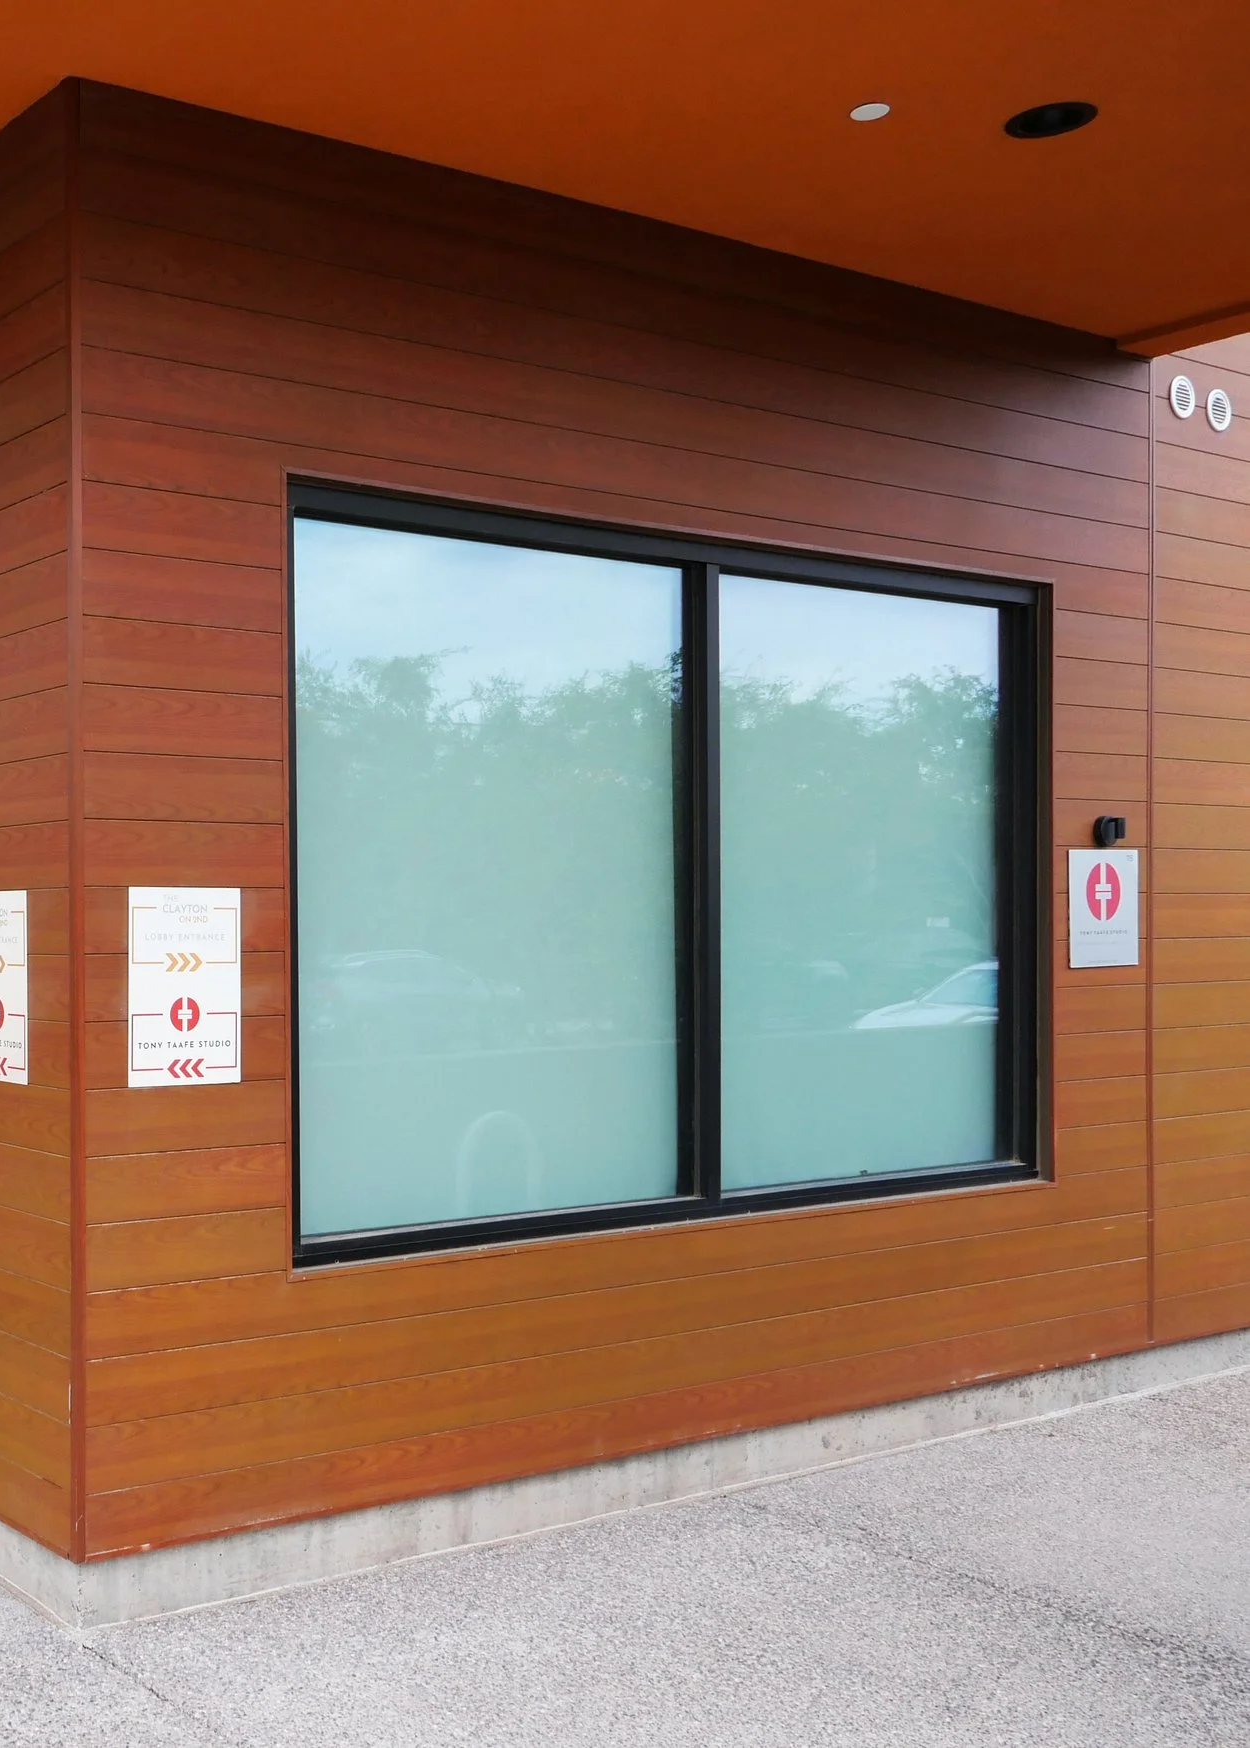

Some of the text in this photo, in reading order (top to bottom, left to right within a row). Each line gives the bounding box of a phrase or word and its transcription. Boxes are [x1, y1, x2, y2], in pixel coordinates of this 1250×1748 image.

[163, 894, 179, 902] THE
[162, 904, 208, 913] CLAYTON
[178, 915, 208, 923] ON 2ND
[145, 933, 226, 941] LOBBY ENTRANCE
[3, 1040, 22, 1049] STUDIO
[199, 1040, 231, 1048] STUDIO
